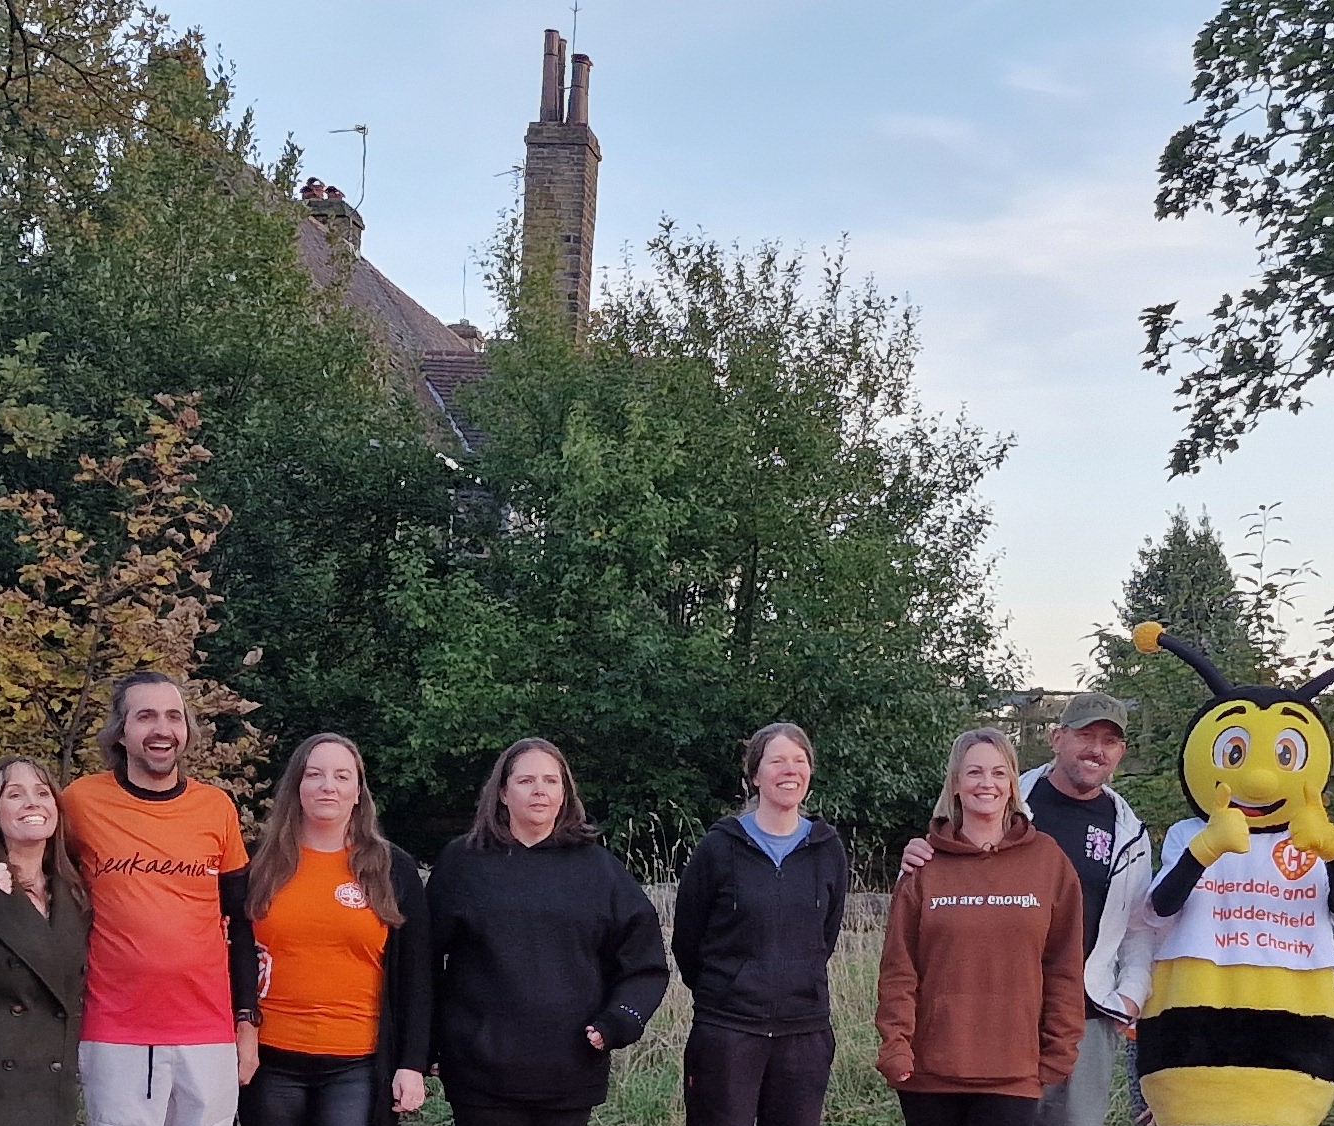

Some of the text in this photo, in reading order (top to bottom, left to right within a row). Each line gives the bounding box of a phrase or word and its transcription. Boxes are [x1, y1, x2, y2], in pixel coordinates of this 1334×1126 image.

[930, 893, 1041, 909] you are enough.
[1283, 884, 1317, 901] and
[1212, 905, 1316, 927] Huddersfield
[1215, 932, 1315, 958] NHS Charity
